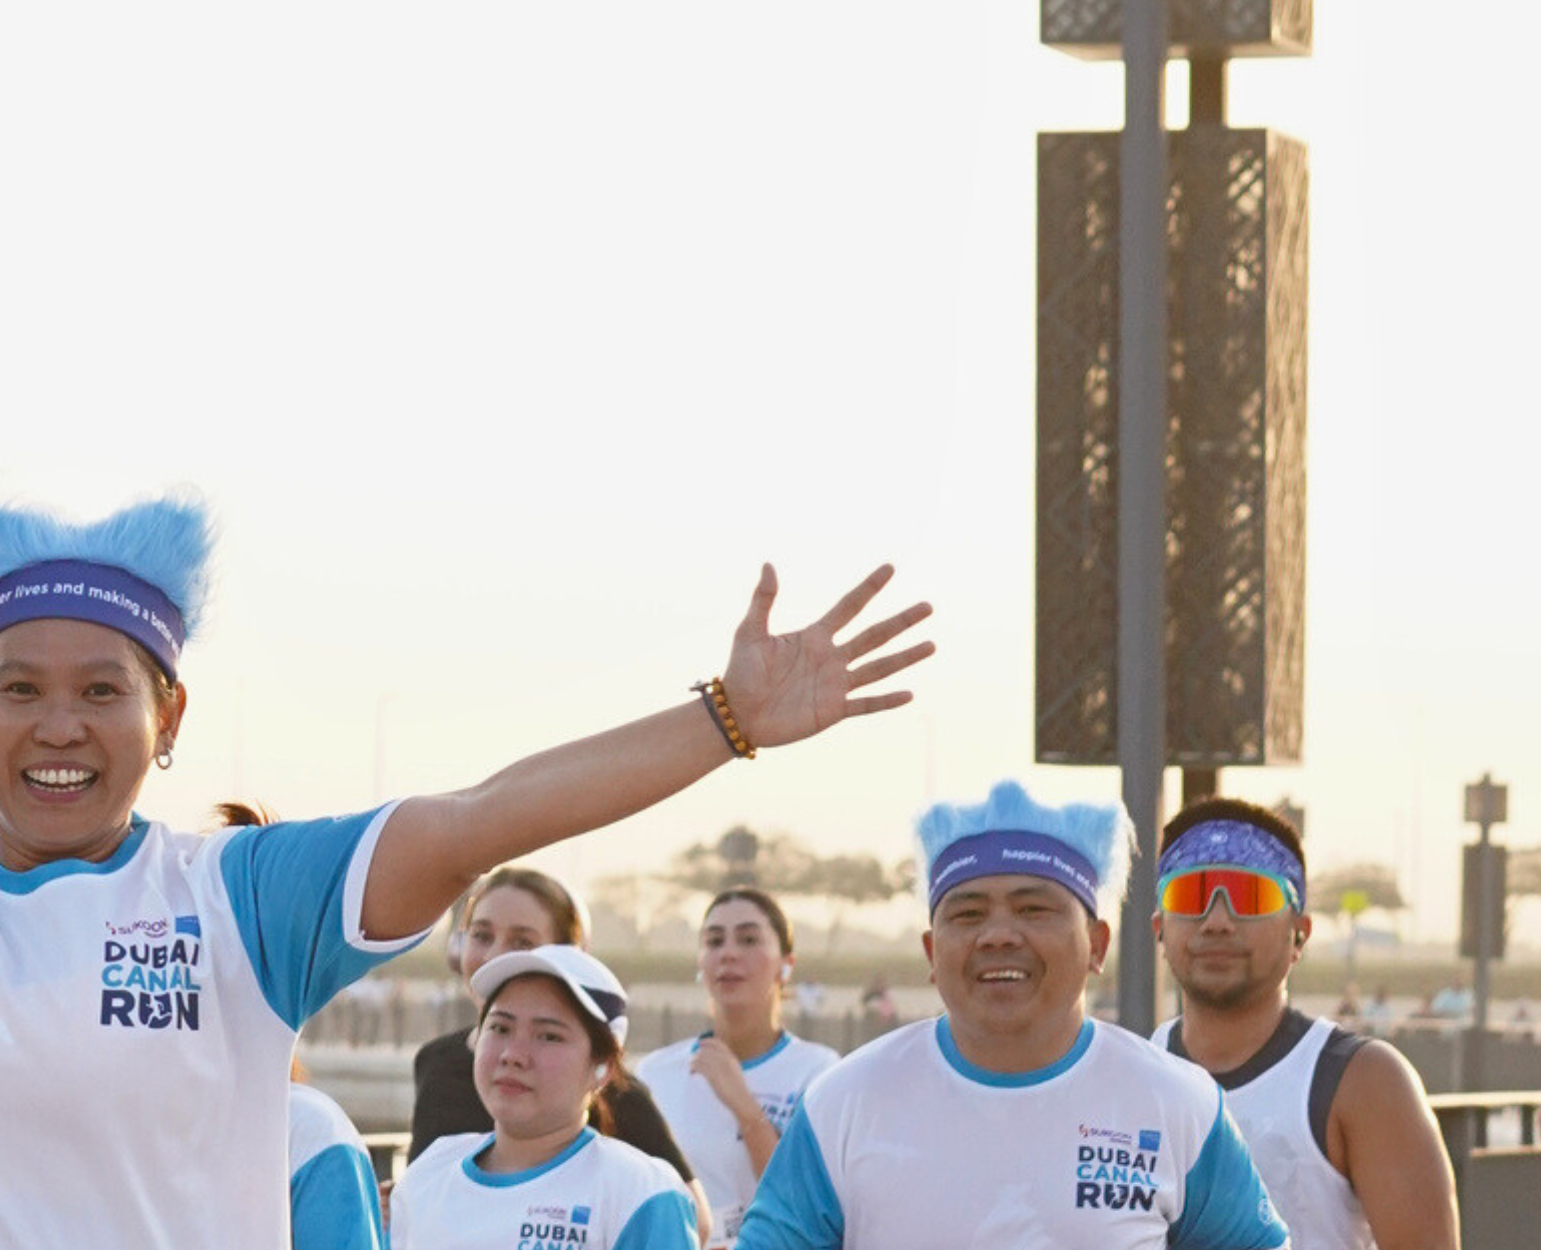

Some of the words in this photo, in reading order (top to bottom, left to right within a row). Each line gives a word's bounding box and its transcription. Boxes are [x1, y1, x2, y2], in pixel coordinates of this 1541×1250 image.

[15, 582, 48, 598] lives
[53, 582, 84, 595] and
[89, 586, 140, 617] making
[105, 939, 199, 968] DUBAI
[102, 964, 201, 992] CANAL
[100, 989, 199, 1030] RUN
[1079, 1146, 1156, 1173] DUBAI
[1077, 1164, 1158, 1188] CANAL
[1077, 1182, 1156, 1211] RUN
[520, 1223, 587, 1244] DUBAI
